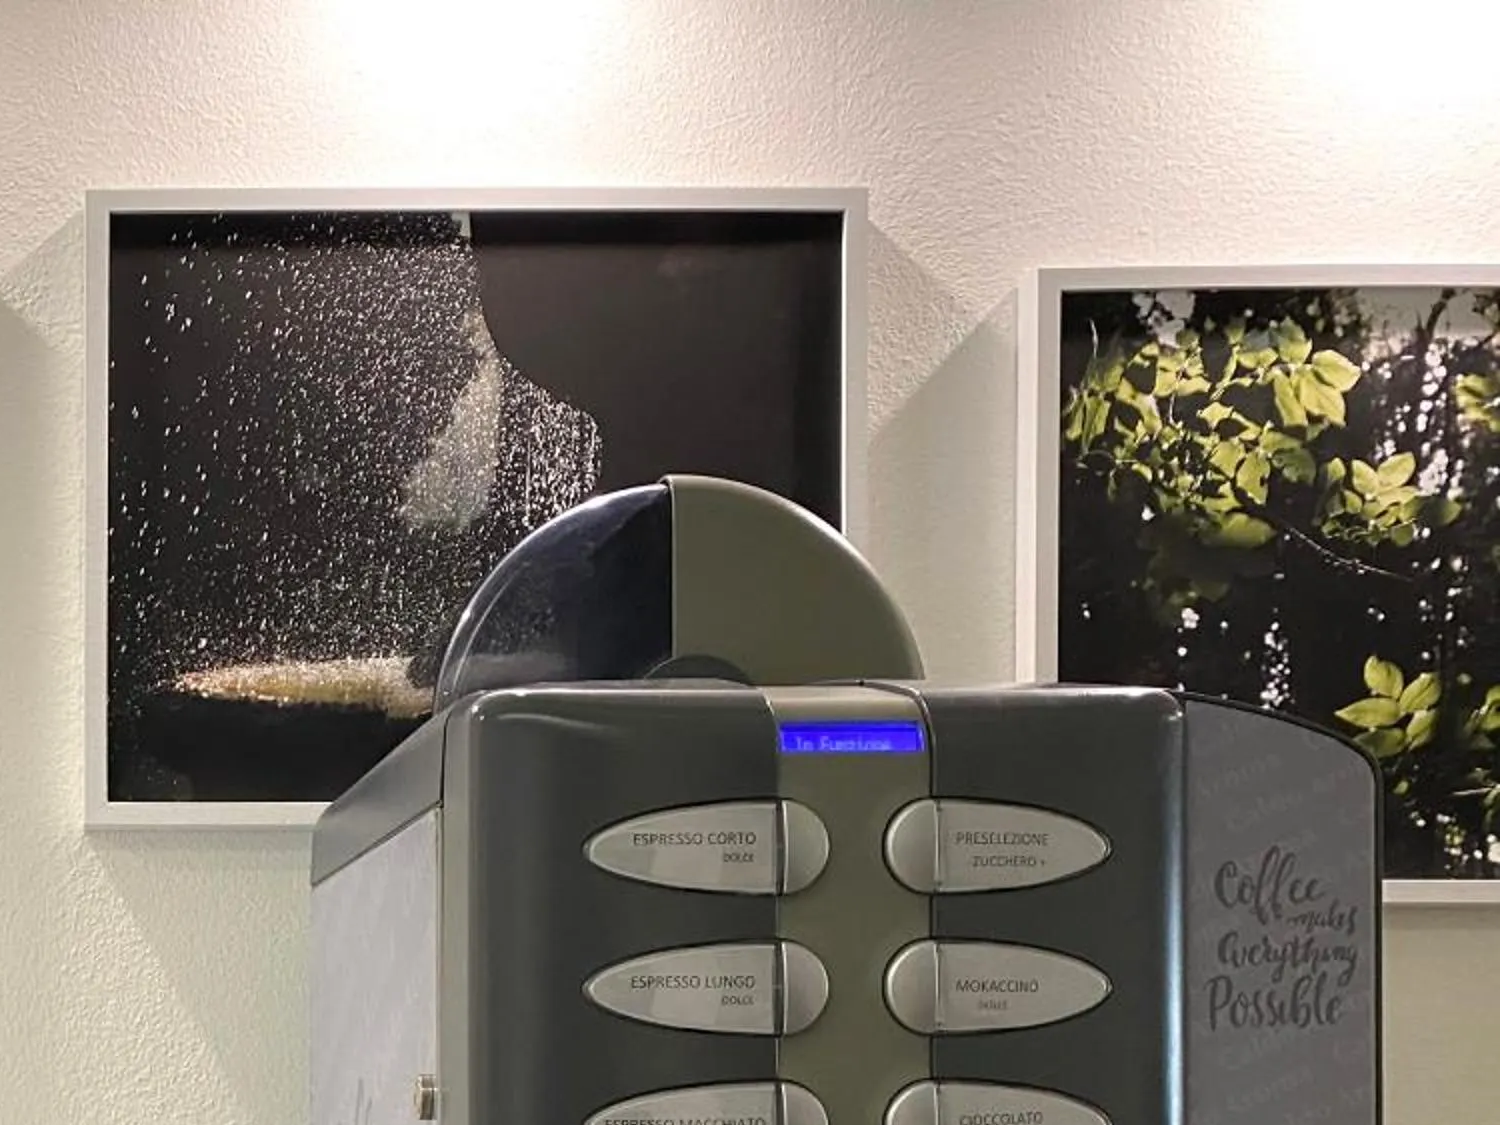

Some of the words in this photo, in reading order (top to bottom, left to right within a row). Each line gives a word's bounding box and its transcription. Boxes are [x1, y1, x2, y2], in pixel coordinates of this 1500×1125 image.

[633, 831, 703, 846] ESPRESSO
[707, 831, 757, 846] CORTO
[955, 831, 1050, 847] PRESELEZIONE
[722, 851, 755, 863] DOLCE
[972, 855, 1037, 868] ZUCCHERO
[1214, 845, 1326, 926] Coffee
[630, 974, 702, 989] ESPRESSO
[704, 974, 756, 989] LUNGO
[954, 979, 1040, 993] MOKACCINO
[721, 994, 755, 1006] DOLCE
[1203, 973, 1345, 1032] Possible
